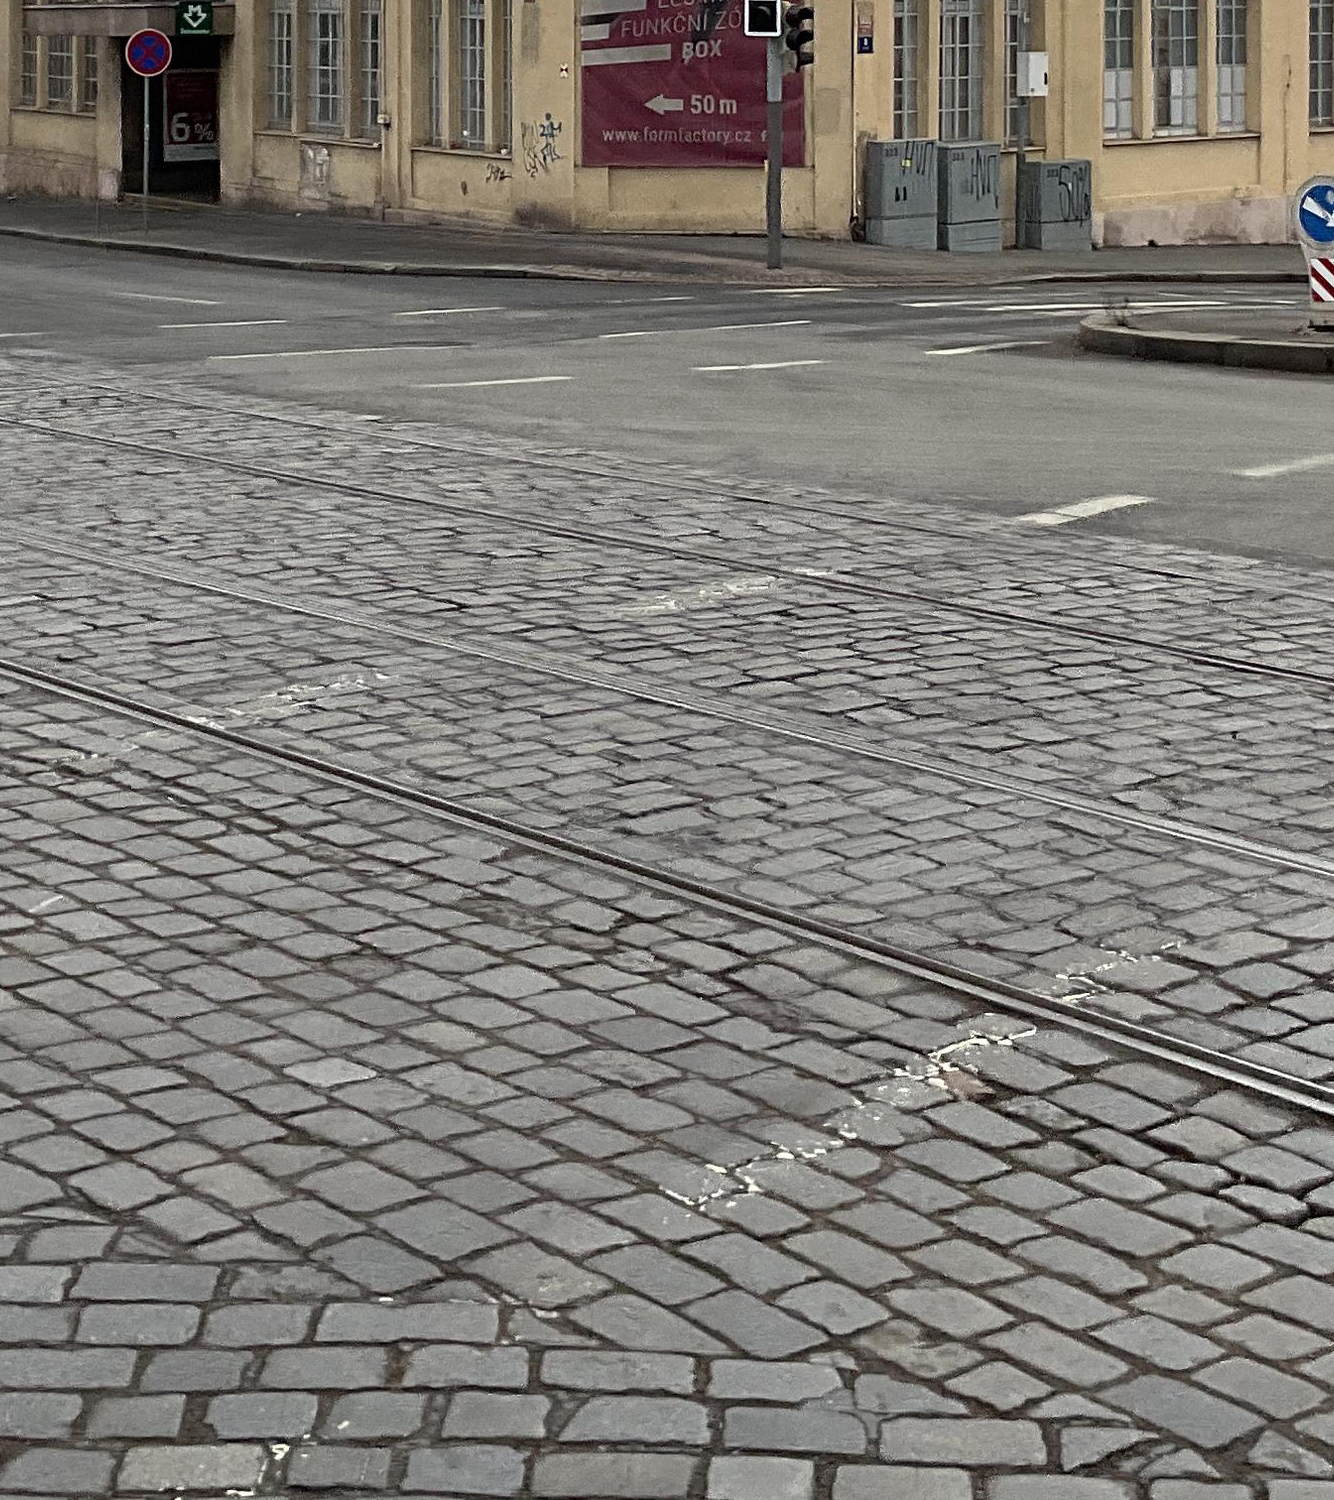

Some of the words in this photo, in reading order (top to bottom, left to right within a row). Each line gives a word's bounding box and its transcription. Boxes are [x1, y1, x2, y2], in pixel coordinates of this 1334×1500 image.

[620, 8, 709, 39] FUNKČNÍ
[682, 39, 723, 61] BOX
[690, 94, 715, 115] 50
[720, 99, 738, 115] m
[602, 125, 752, 146] www.formfactory.cz
